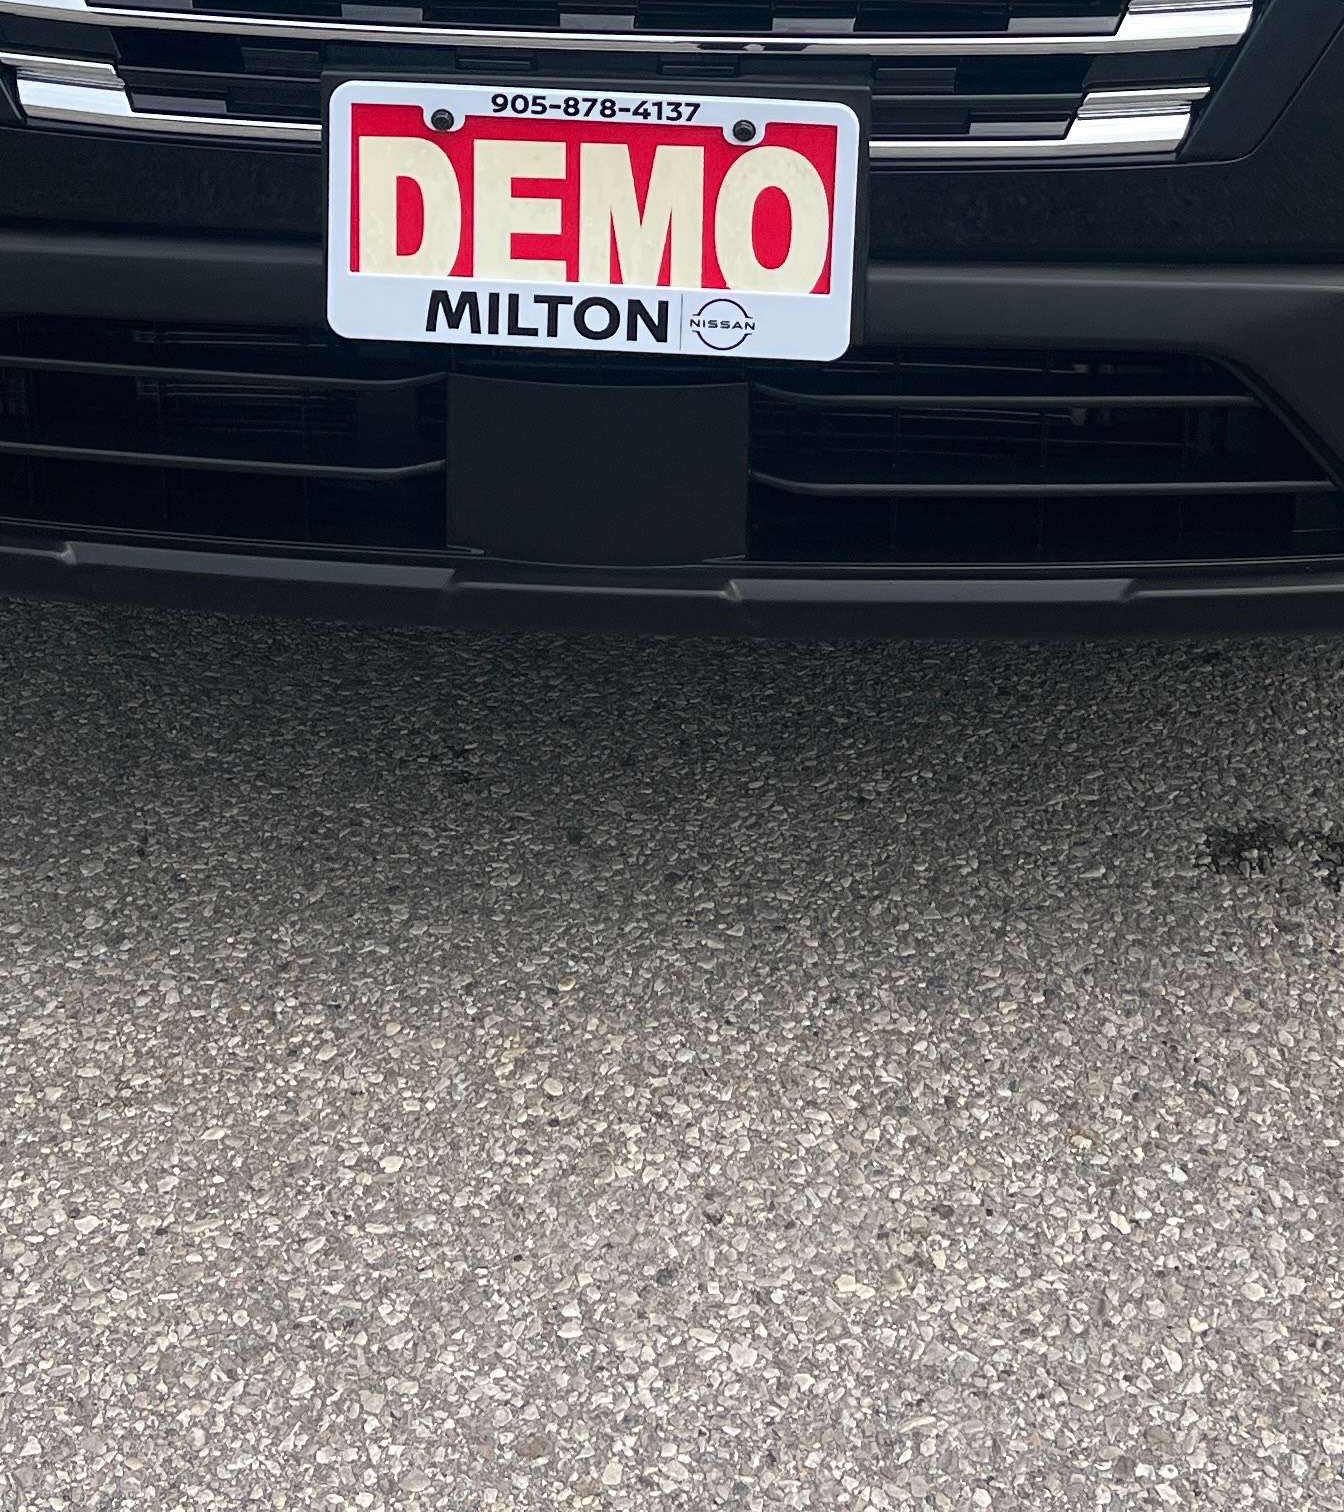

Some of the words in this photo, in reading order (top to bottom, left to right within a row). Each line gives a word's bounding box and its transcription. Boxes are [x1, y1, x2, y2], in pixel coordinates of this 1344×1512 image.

[491, 92, 701, 122] 905-878-4137
[358, 135, 831, 295] DEMO
[425, 289, 670, 344] MILTON
[689, 318, 756, 331] NISSAN
